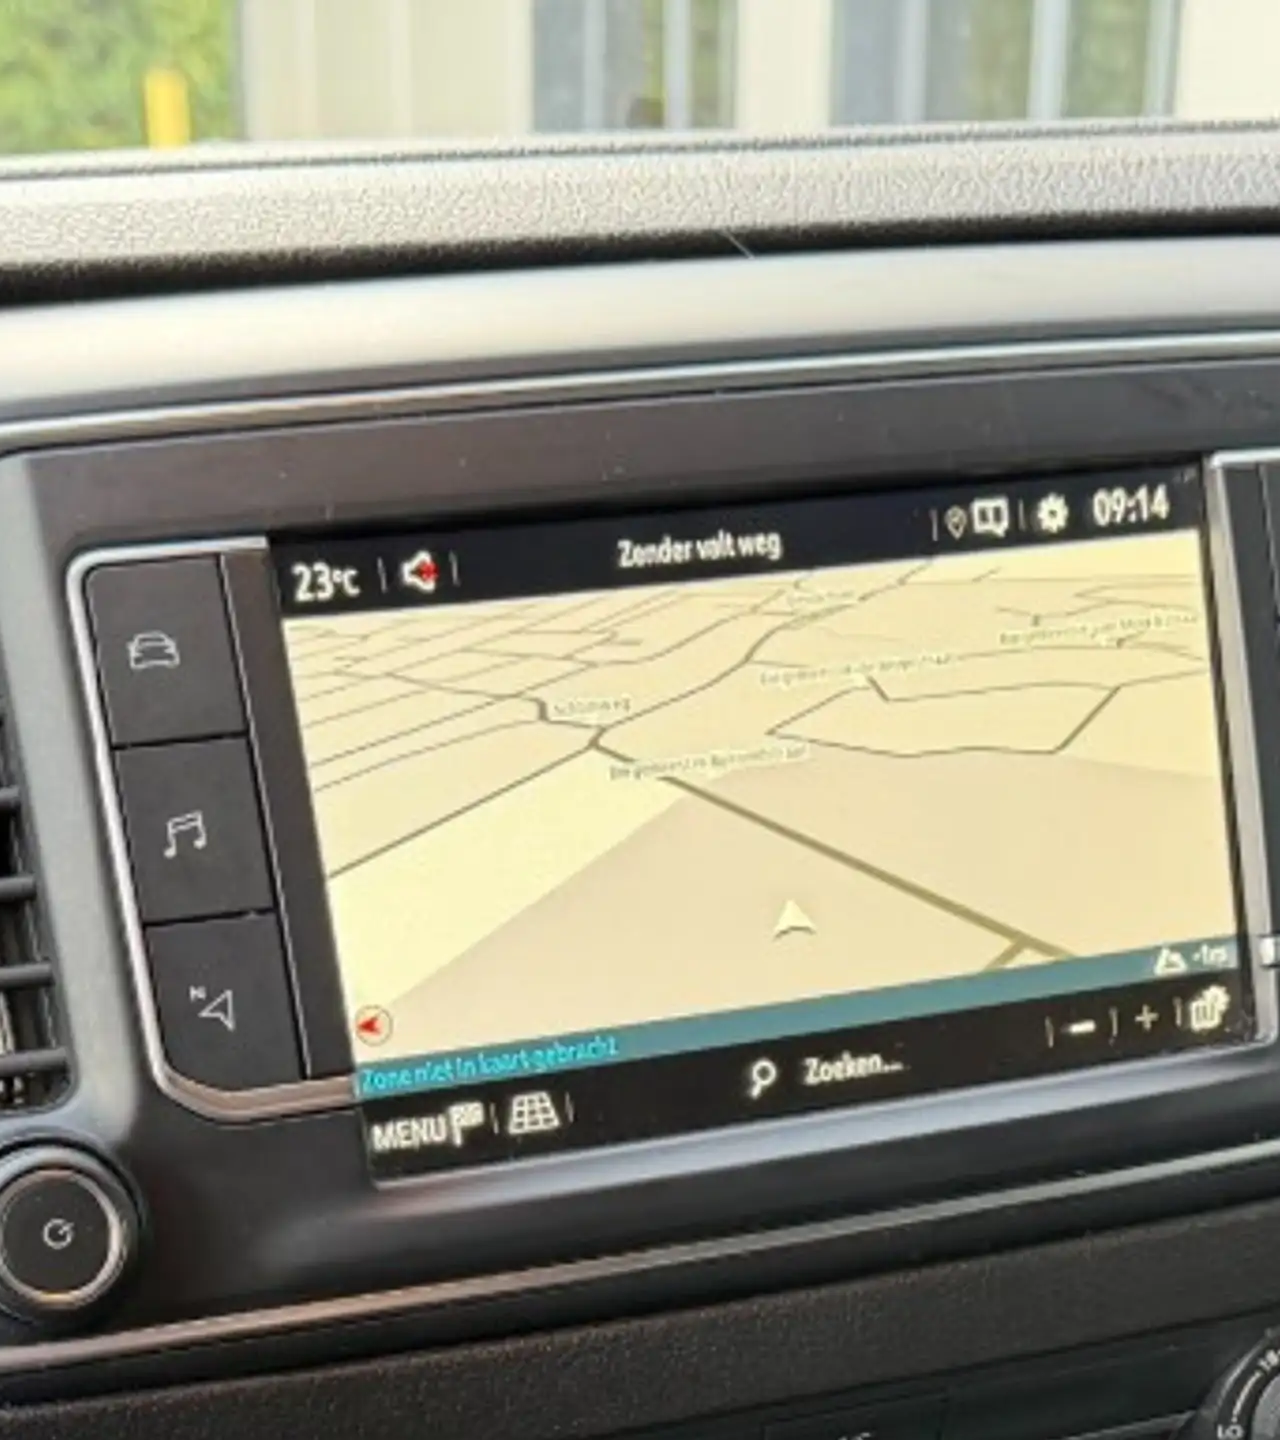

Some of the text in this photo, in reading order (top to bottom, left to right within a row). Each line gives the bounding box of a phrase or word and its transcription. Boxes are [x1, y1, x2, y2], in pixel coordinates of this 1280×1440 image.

[1092, 484, 1169, 527] 09:14
[737, 531, 783, 561] weg
[372, 1113, 448, 1152] MENU
